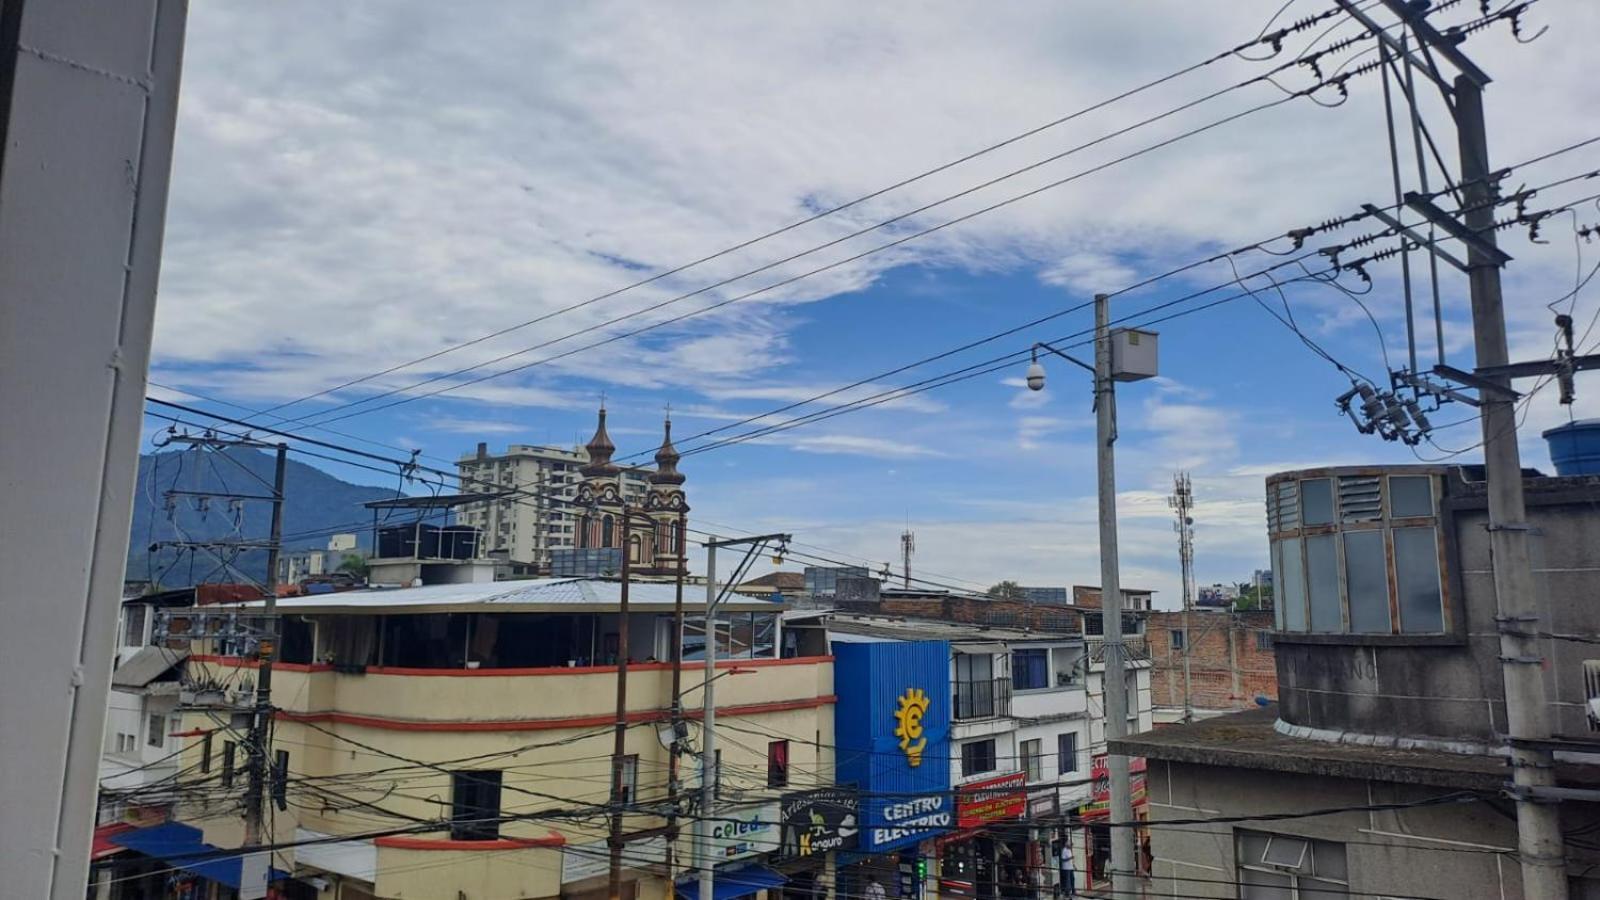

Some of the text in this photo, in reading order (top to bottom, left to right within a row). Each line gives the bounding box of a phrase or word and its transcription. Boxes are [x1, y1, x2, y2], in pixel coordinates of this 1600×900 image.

[884, 797, 942, 821] CENTRO
[874, 813, 950, 845] ELECTRICO
[800, 833, 842, 857] Kanguro
